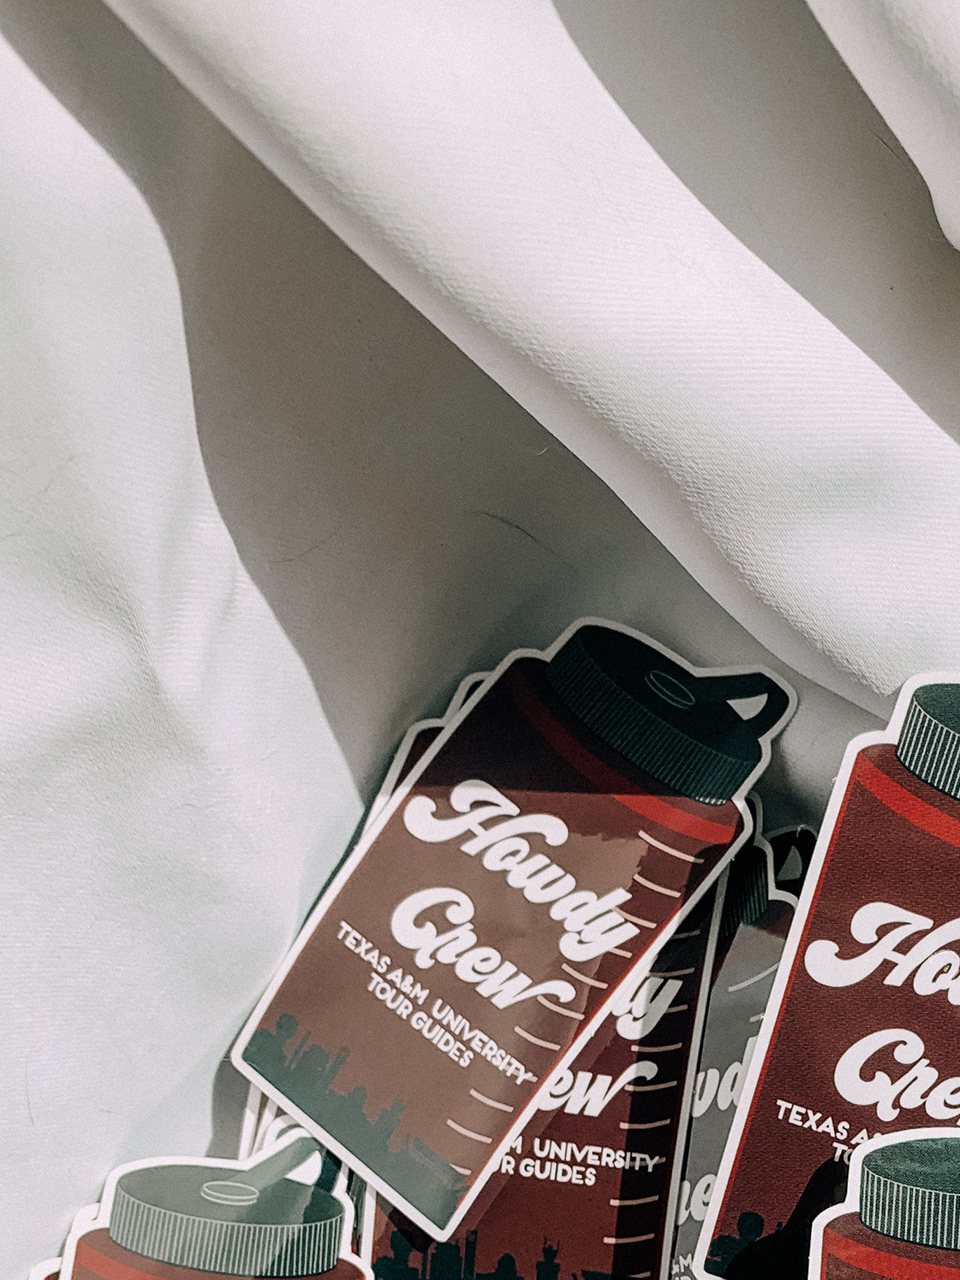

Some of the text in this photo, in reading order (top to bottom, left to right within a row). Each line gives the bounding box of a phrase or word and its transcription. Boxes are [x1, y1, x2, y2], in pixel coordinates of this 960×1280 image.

[404, 780, 640, 962] Howdy
[391, 887, 576, 1009] Crew
[336, 920, 535, 1086] TEXAS A&M UNIVERSITY
[367, 972, 474, 1068] TOUR GUIDES
[533, 1137, 660, 1172] UNIVERSITY
[776, 1099, 850, 1140] TEXAS
[519, 1159, 597, 1186] GUIDES
